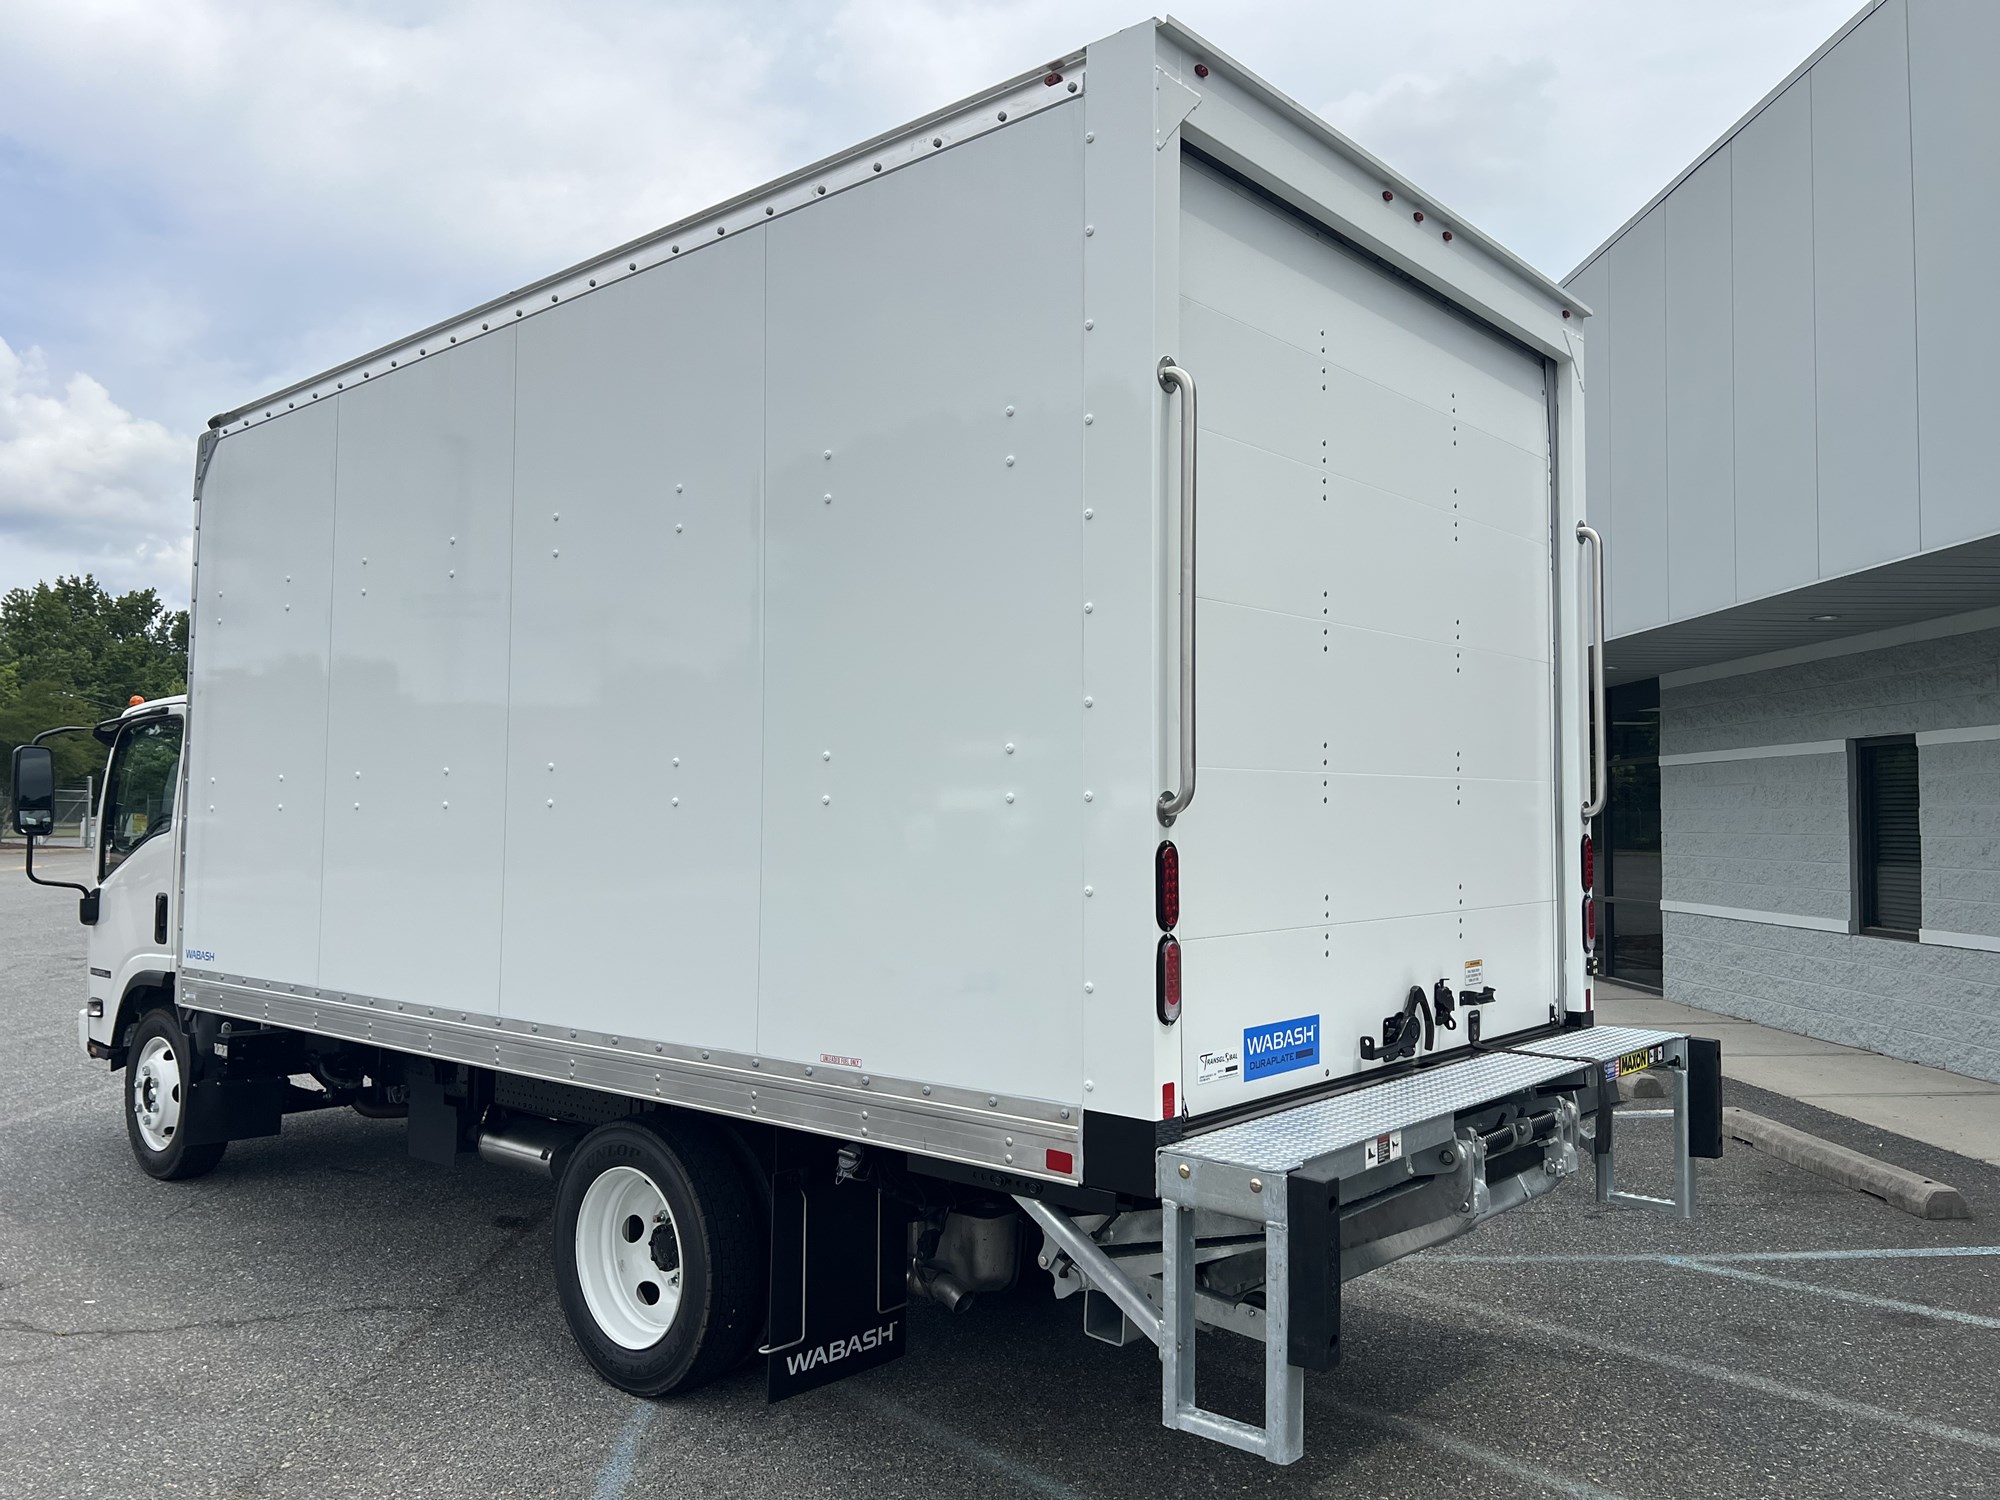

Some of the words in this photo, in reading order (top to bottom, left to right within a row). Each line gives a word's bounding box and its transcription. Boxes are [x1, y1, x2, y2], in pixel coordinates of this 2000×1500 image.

[185, 949, 215, 962] WABASH
[1247, 1024, 1314, 1055] WABASH
[1249, 1052, 1295, 1070] DURAPLATE
[1621, 1050, 1646, 1073] MAXON
[579, 1144, 640, 1173] UNLOP
[786, 1321, 893, 1376] WABASH
